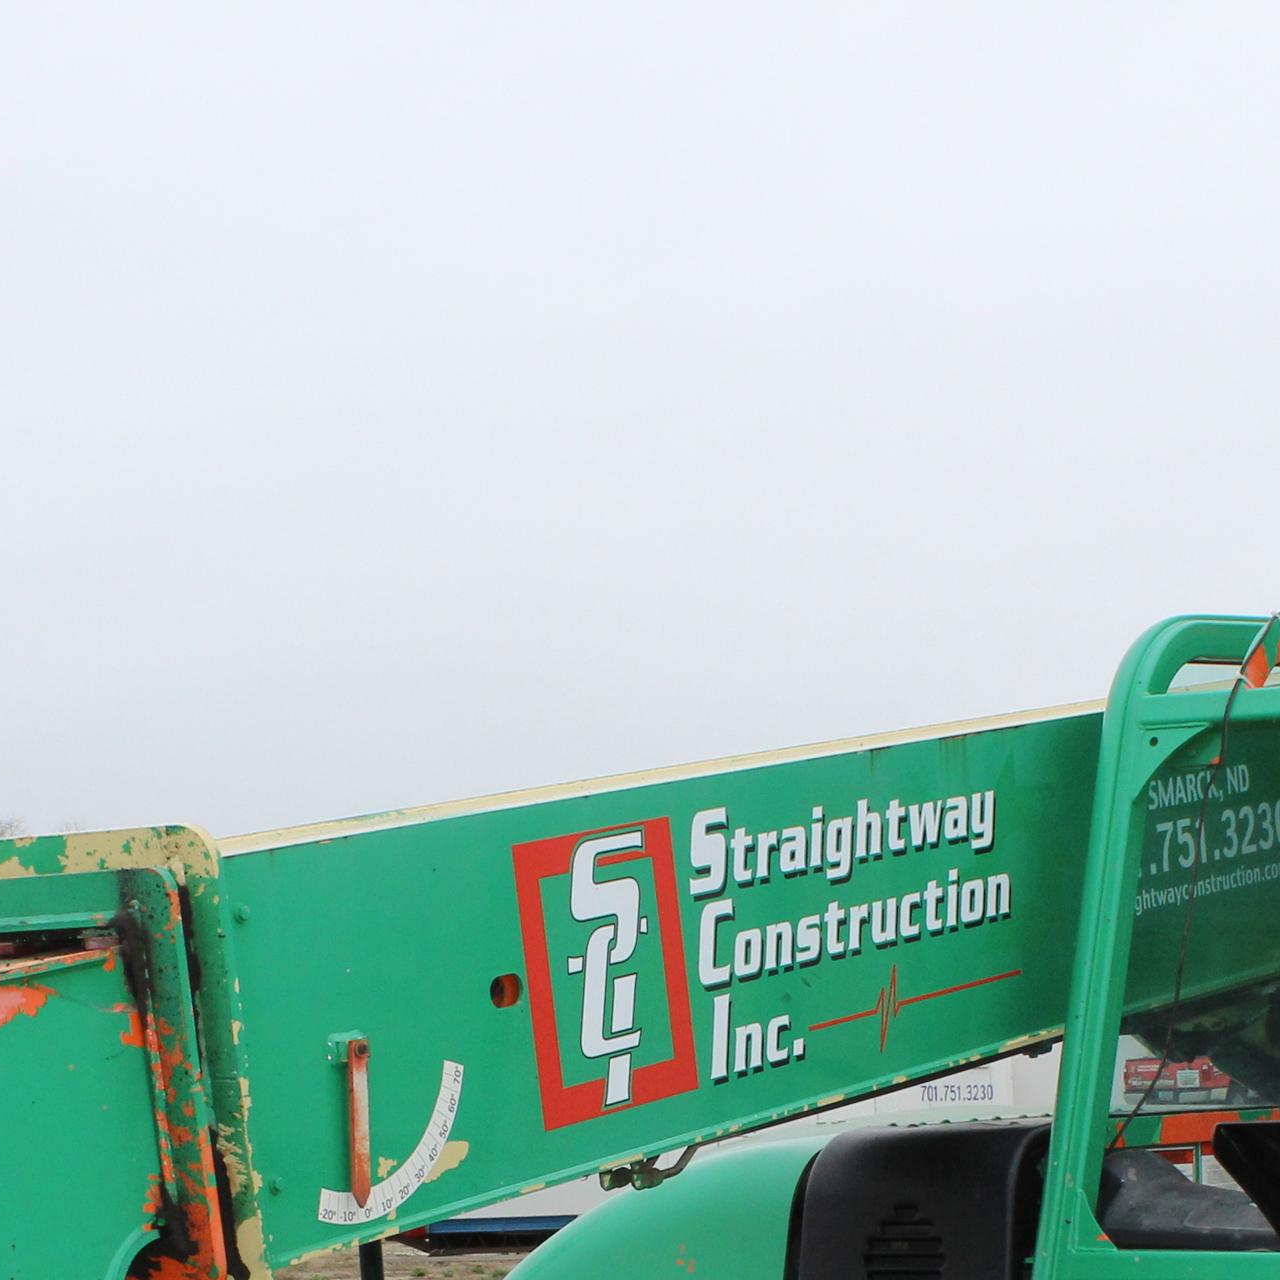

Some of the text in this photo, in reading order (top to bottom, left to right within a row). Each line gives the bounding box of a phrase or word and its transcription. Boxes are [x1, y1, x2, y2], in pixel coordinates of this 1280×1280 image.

[1226, 764, 1250, 795] ND
[689, 790, 994, 895] Straightway
[697, 868, 1013, 986] Construction
[710, 993, 807, 1082] Inc.
[921, 1083, 994, 1102] 701.751.3230
